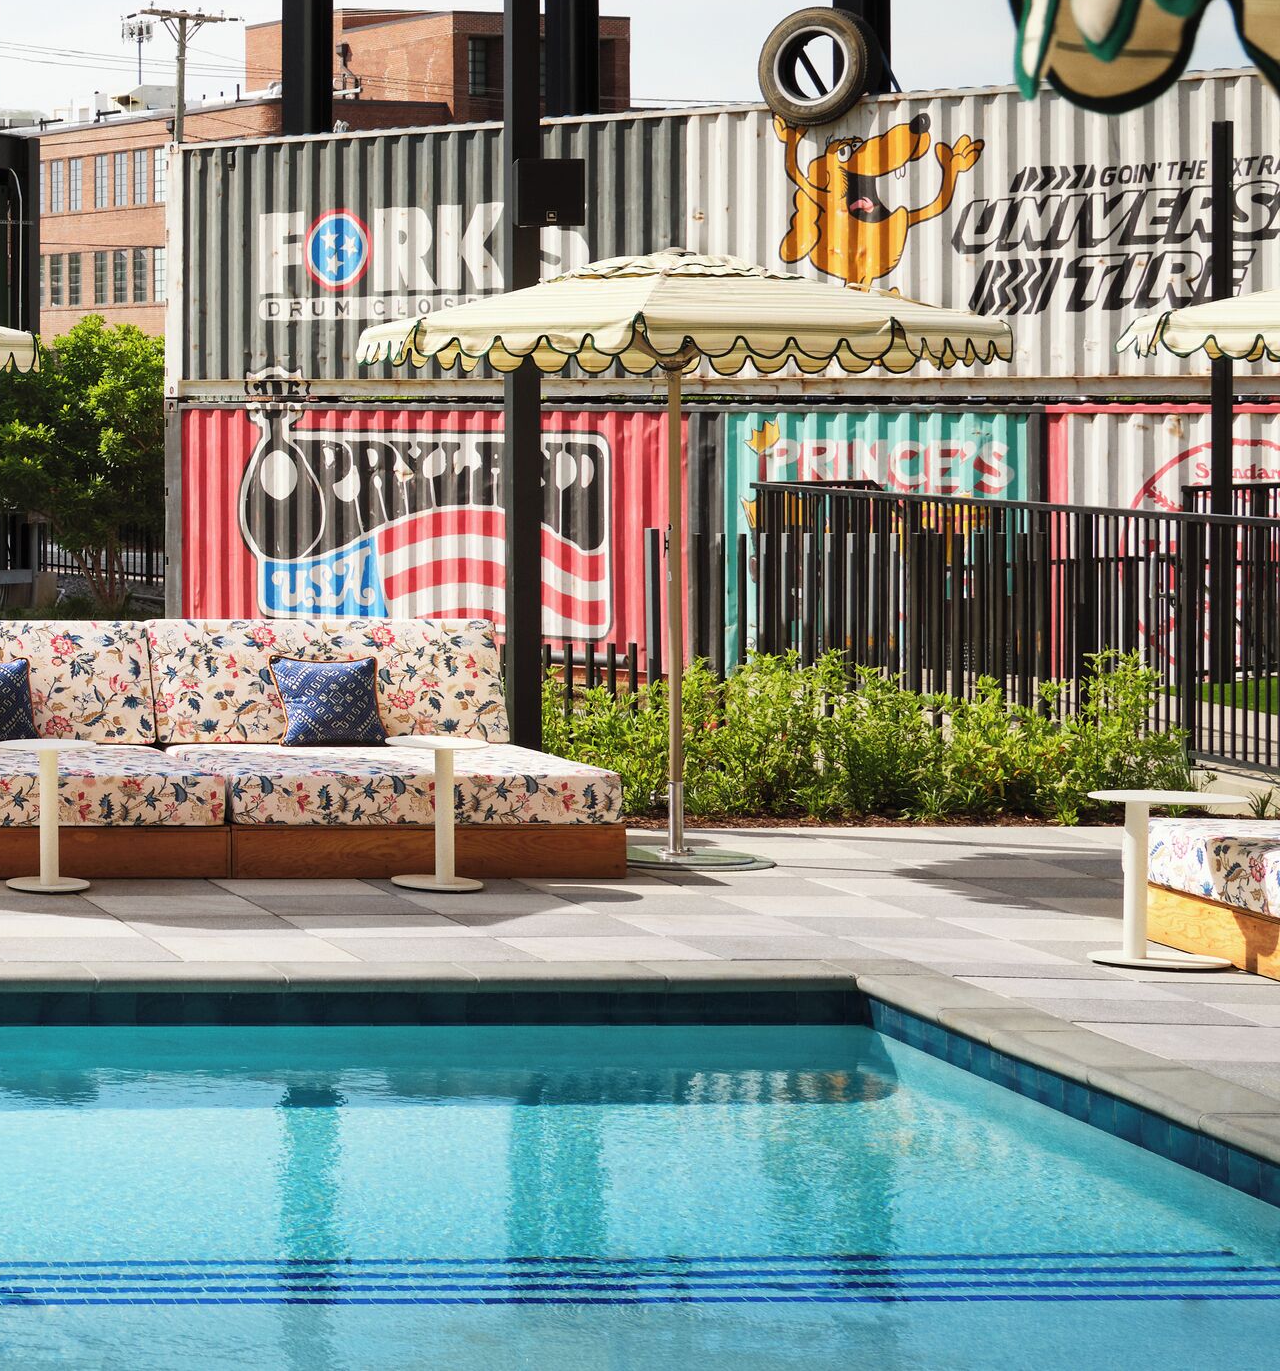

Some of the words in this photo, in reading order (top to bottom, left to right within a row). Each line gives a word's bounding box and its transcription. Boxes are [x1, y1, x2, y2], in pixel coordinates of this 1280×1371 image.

[1100, 163, 1161, 186] GOIN'
[1167, 159, 1208, 181] THE
[951, 180, 1280, 254] UNIVERS
[268, 300, 350, 318] DRUM
[758, 438, 1014, 495] PRINCE'S
[271, 543, 375, 607] USA
